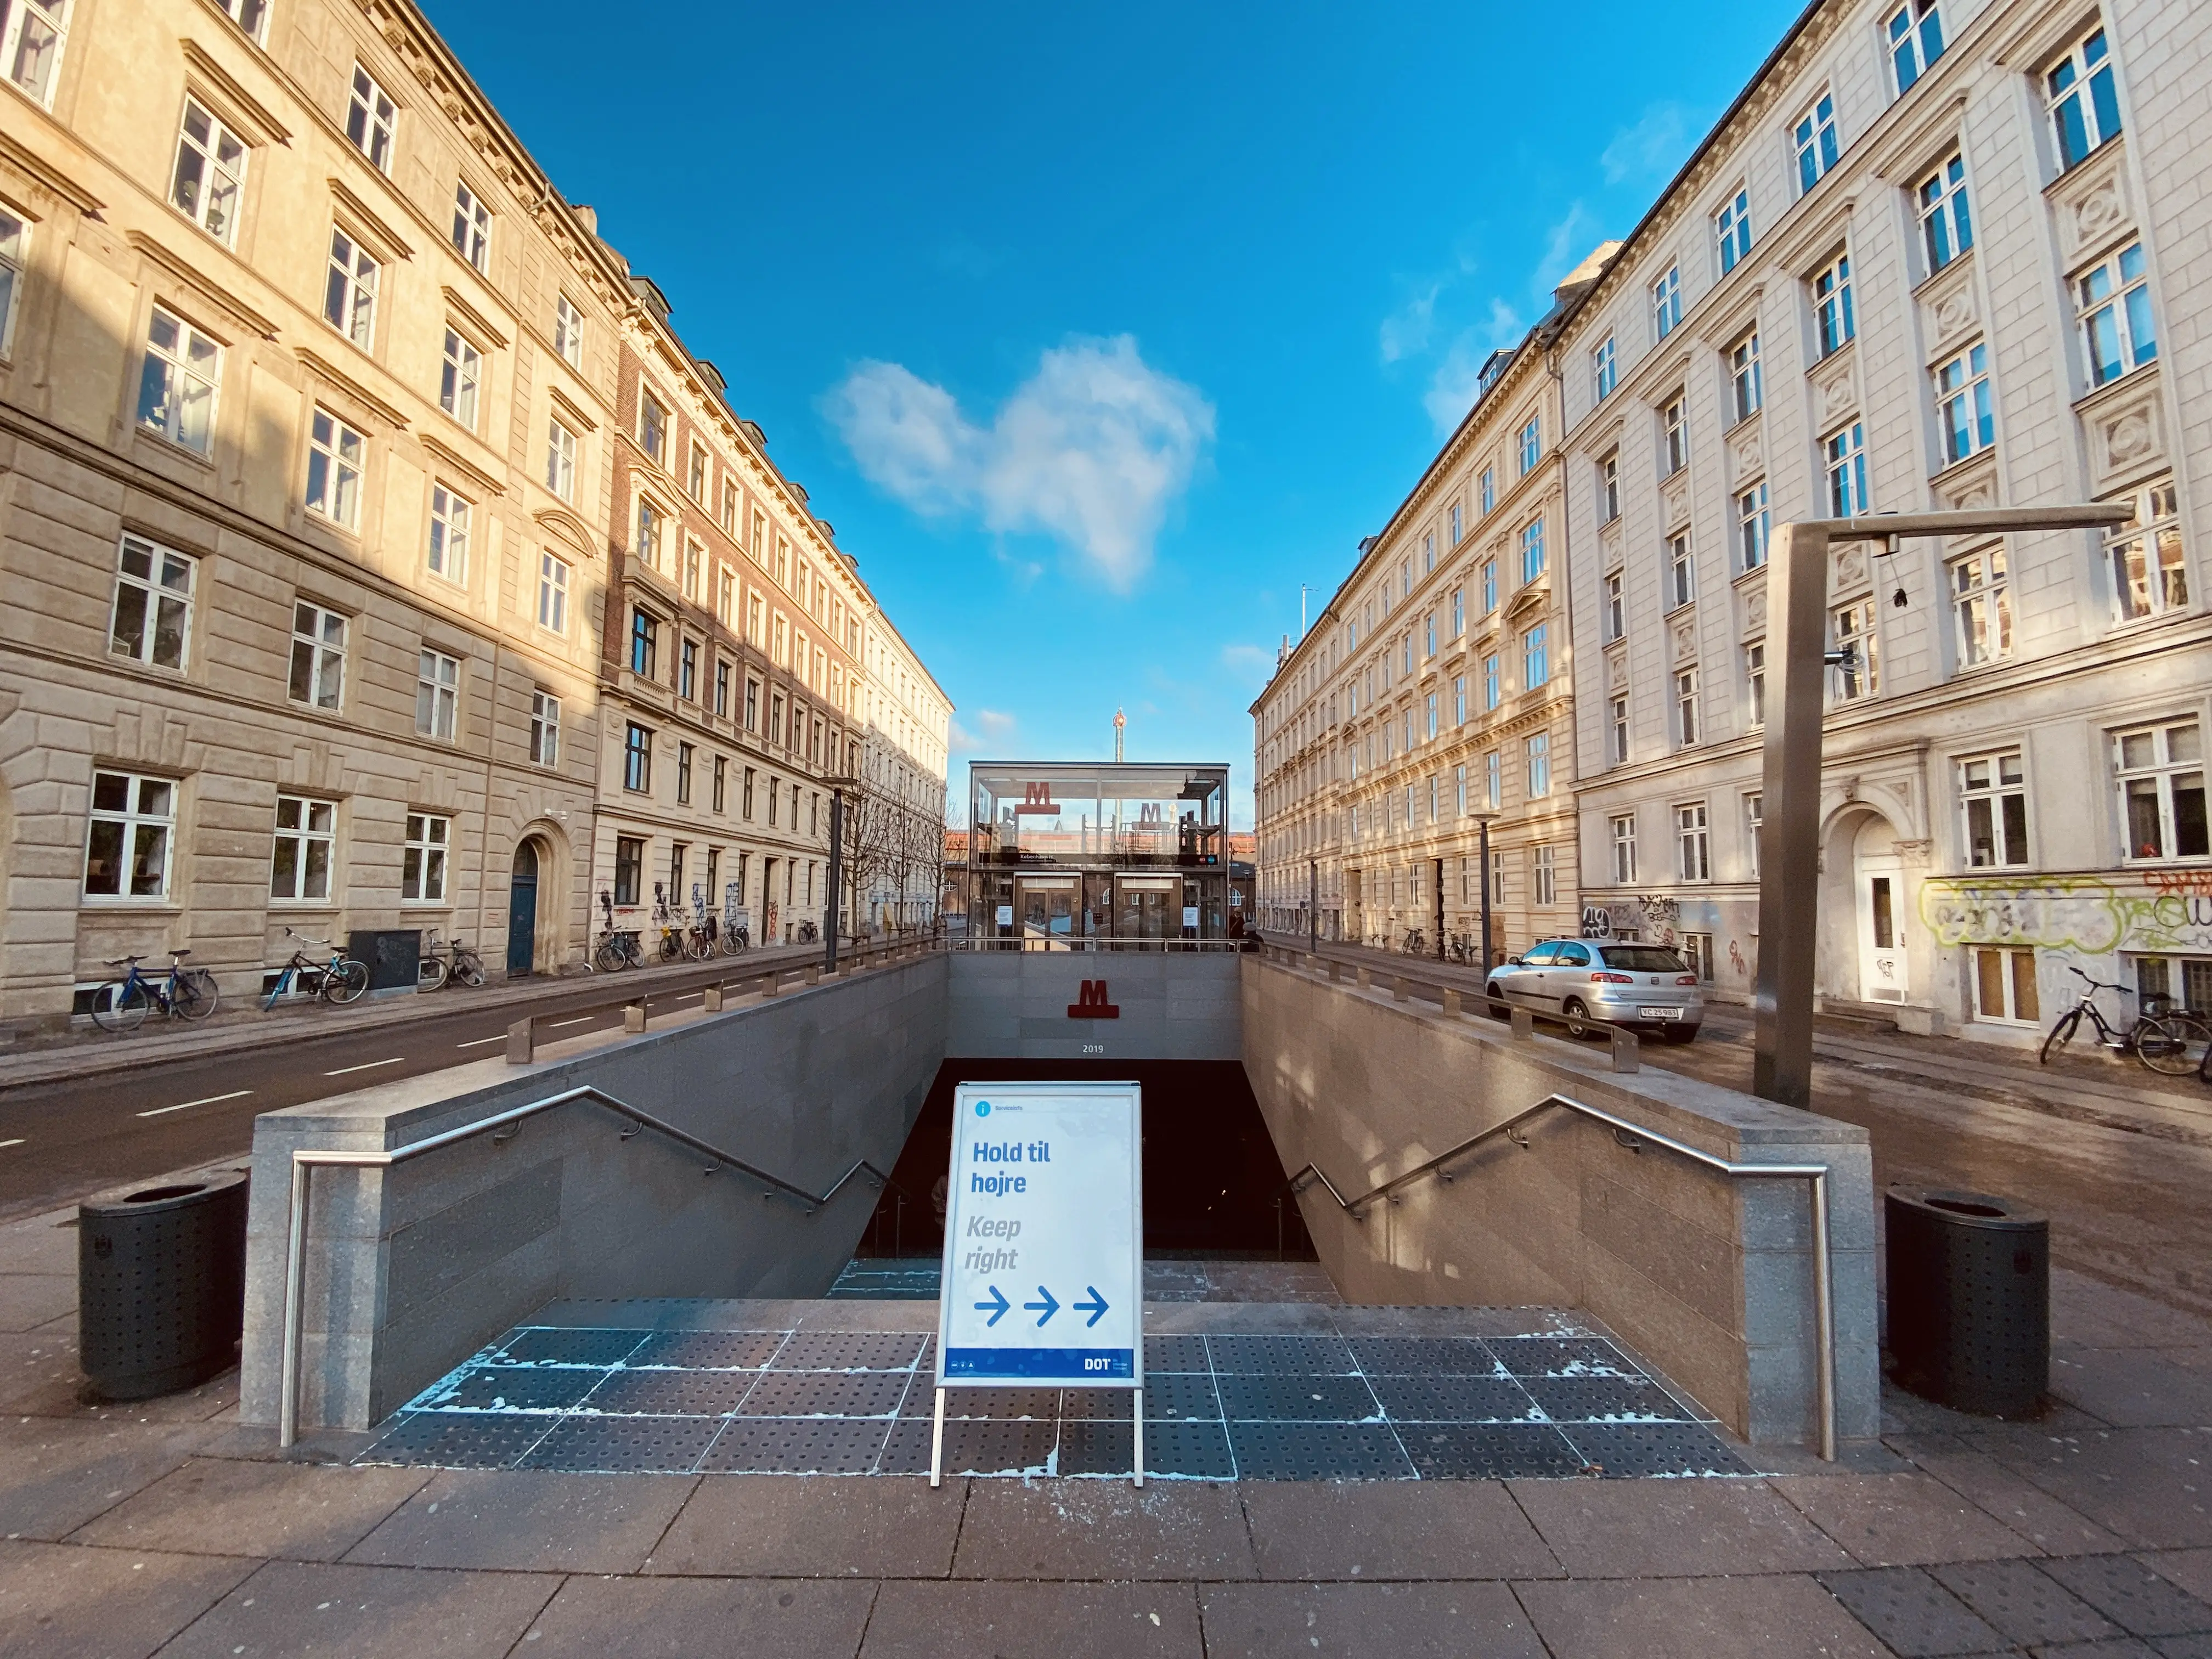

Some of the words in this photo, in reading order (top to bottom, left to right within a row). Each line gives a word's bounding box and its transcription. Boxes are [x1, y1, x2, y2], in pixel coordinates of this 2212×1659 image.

[1082, 1045, 1104, 1053] 2019
[973, 1142, 1022, 1162] Hold
[1028, 1141, 1051, 1162] til
[971, 1170, 1026, 1197] højre
[967, 1216, 1021, 1242] Keep
[964, 1246, 1019, 1274] right
[1085, 1358, 1111, 1370] DOT
